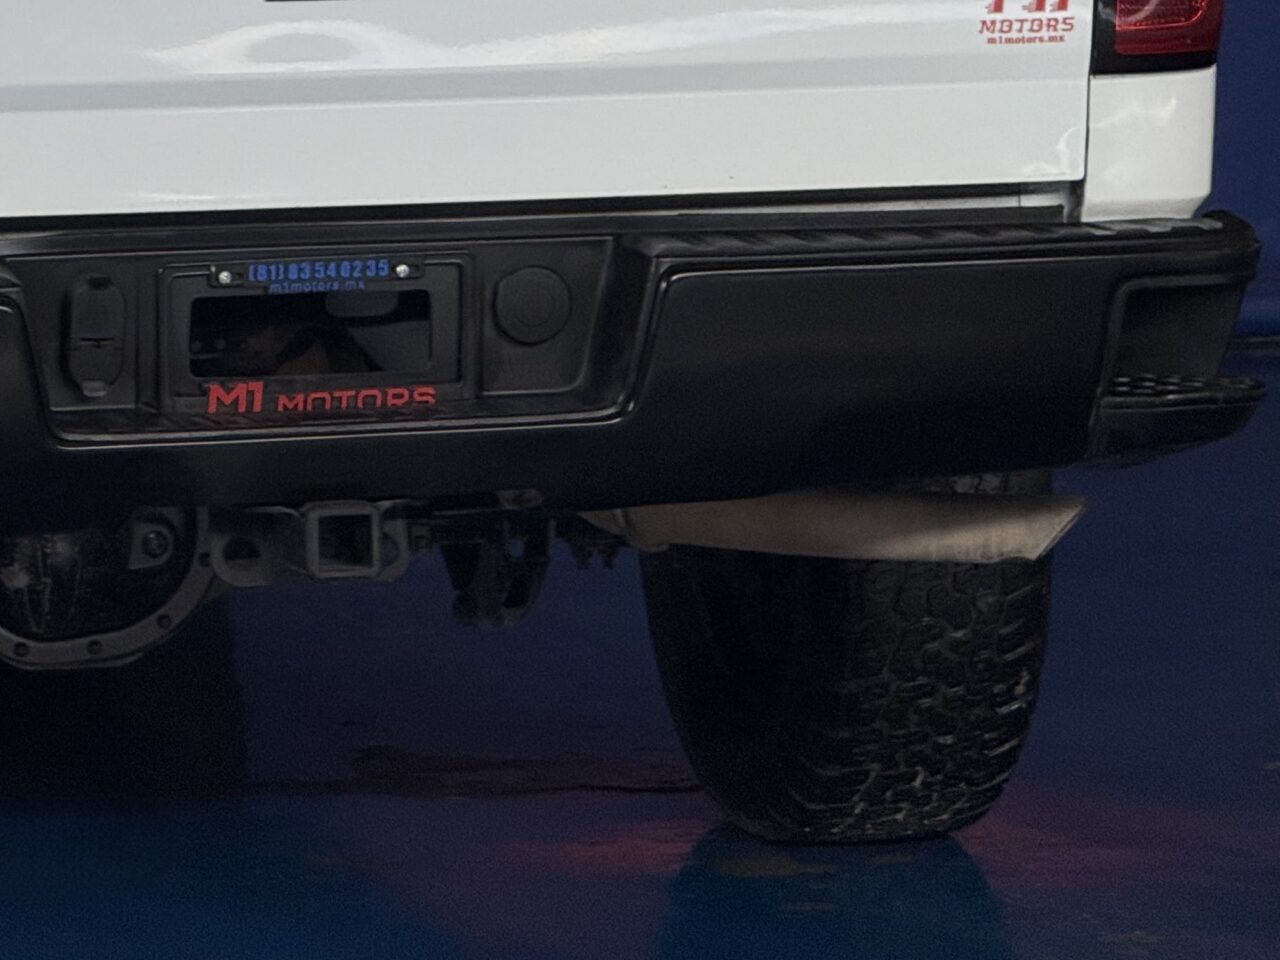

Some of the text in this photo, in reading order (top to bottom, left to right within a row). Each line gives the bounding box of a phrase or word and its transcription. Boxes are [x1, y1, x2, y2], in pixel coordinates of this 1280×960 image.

[978, 17, 1075, 34] MOTORS
[986, 35, 1066, 45] m1motors.mx
[207, 380, 436, 414] M1 MOTORS
